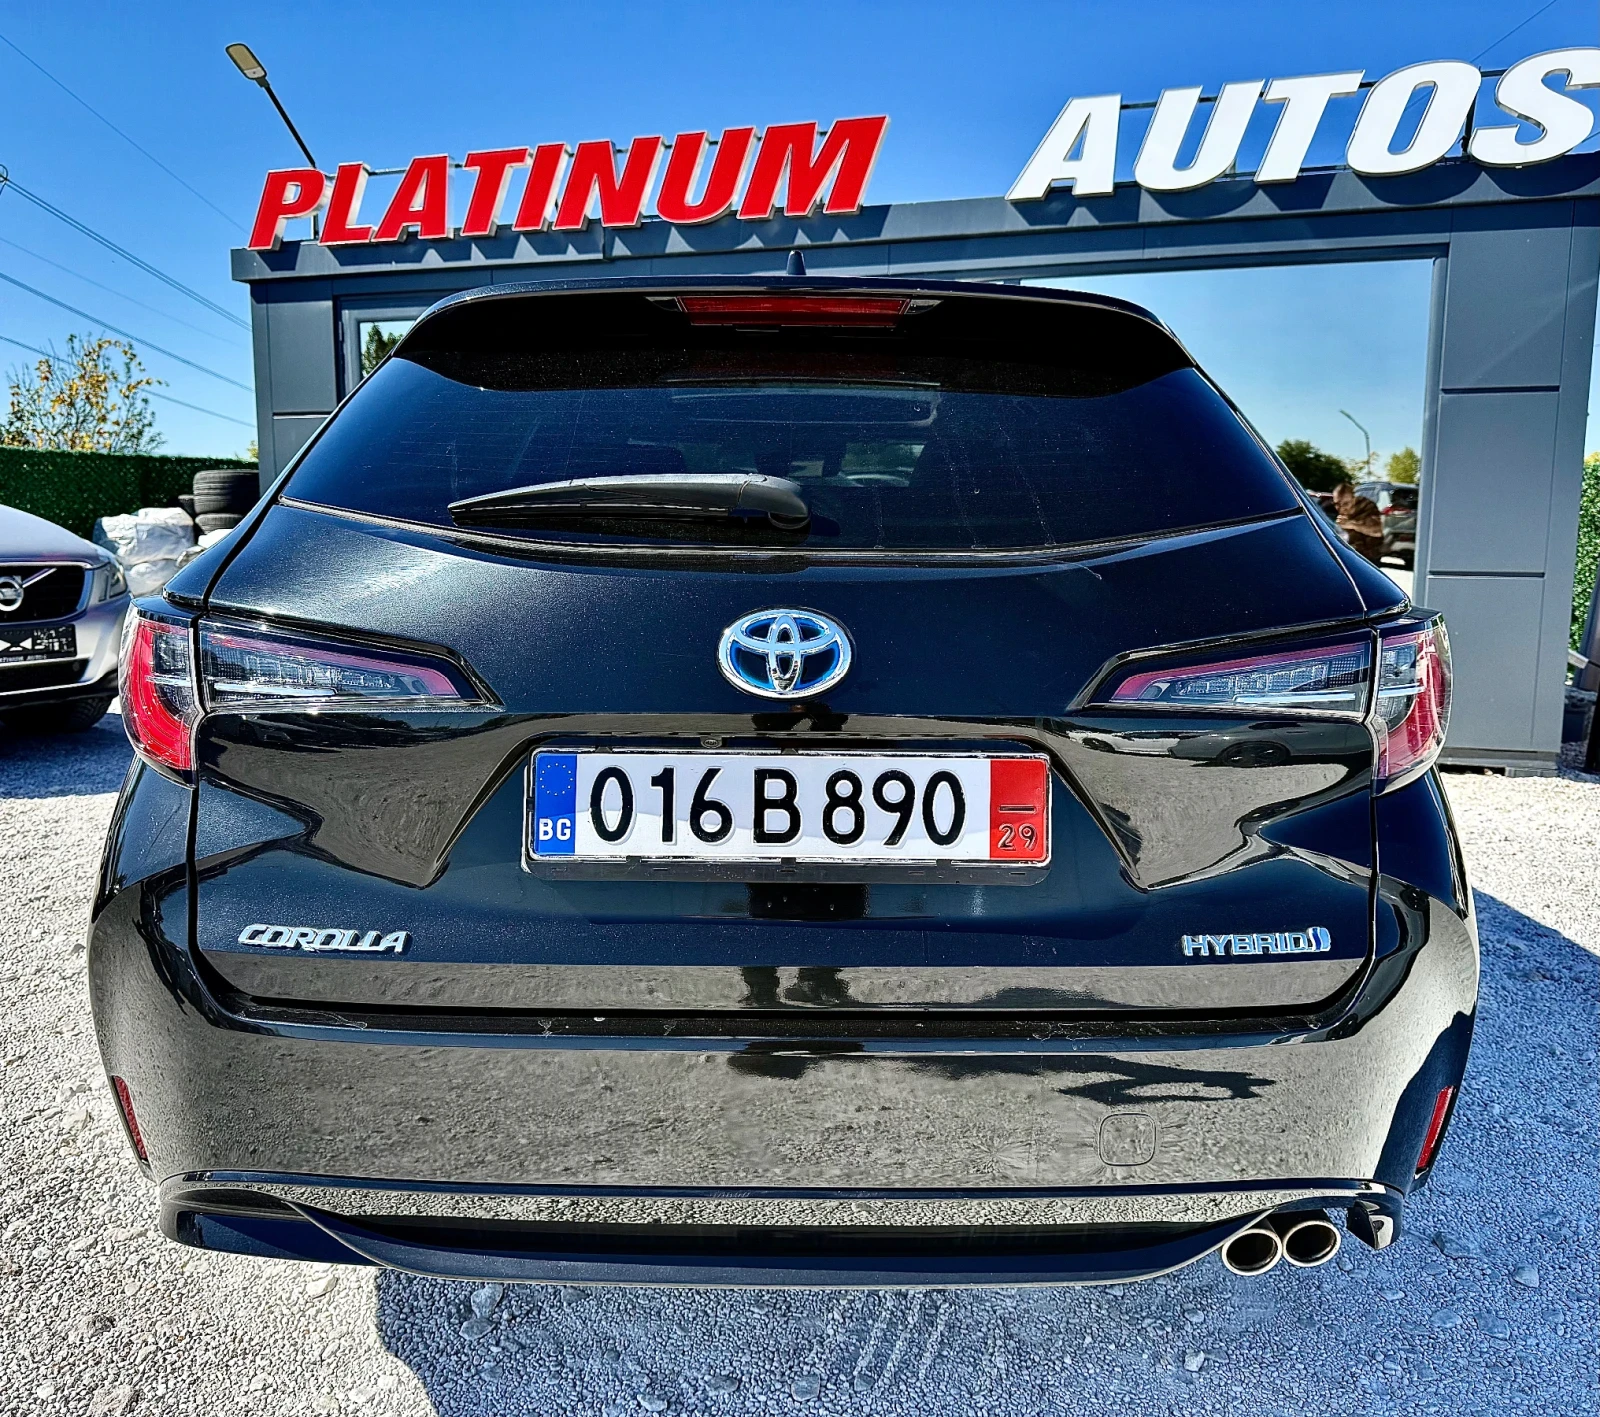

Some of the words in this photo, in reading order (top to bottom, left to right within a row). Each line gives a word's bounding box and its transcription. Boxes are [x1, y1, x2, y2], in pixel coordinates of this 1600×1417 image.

[247, 115, 889, 251] PLATINUM
[1004, 46, 1600, 202] AUTOS
[590, 765, 734, 845] 016
[753, 768, 801, 845] B
[823, 768, 965, 847] 890
[538, 818, 572, 842] BG
[996, 823, 1037, 851] 29
[237, 923, 409, 953] COROLLA
[1181, 931, 1309, 956] HYBRID
